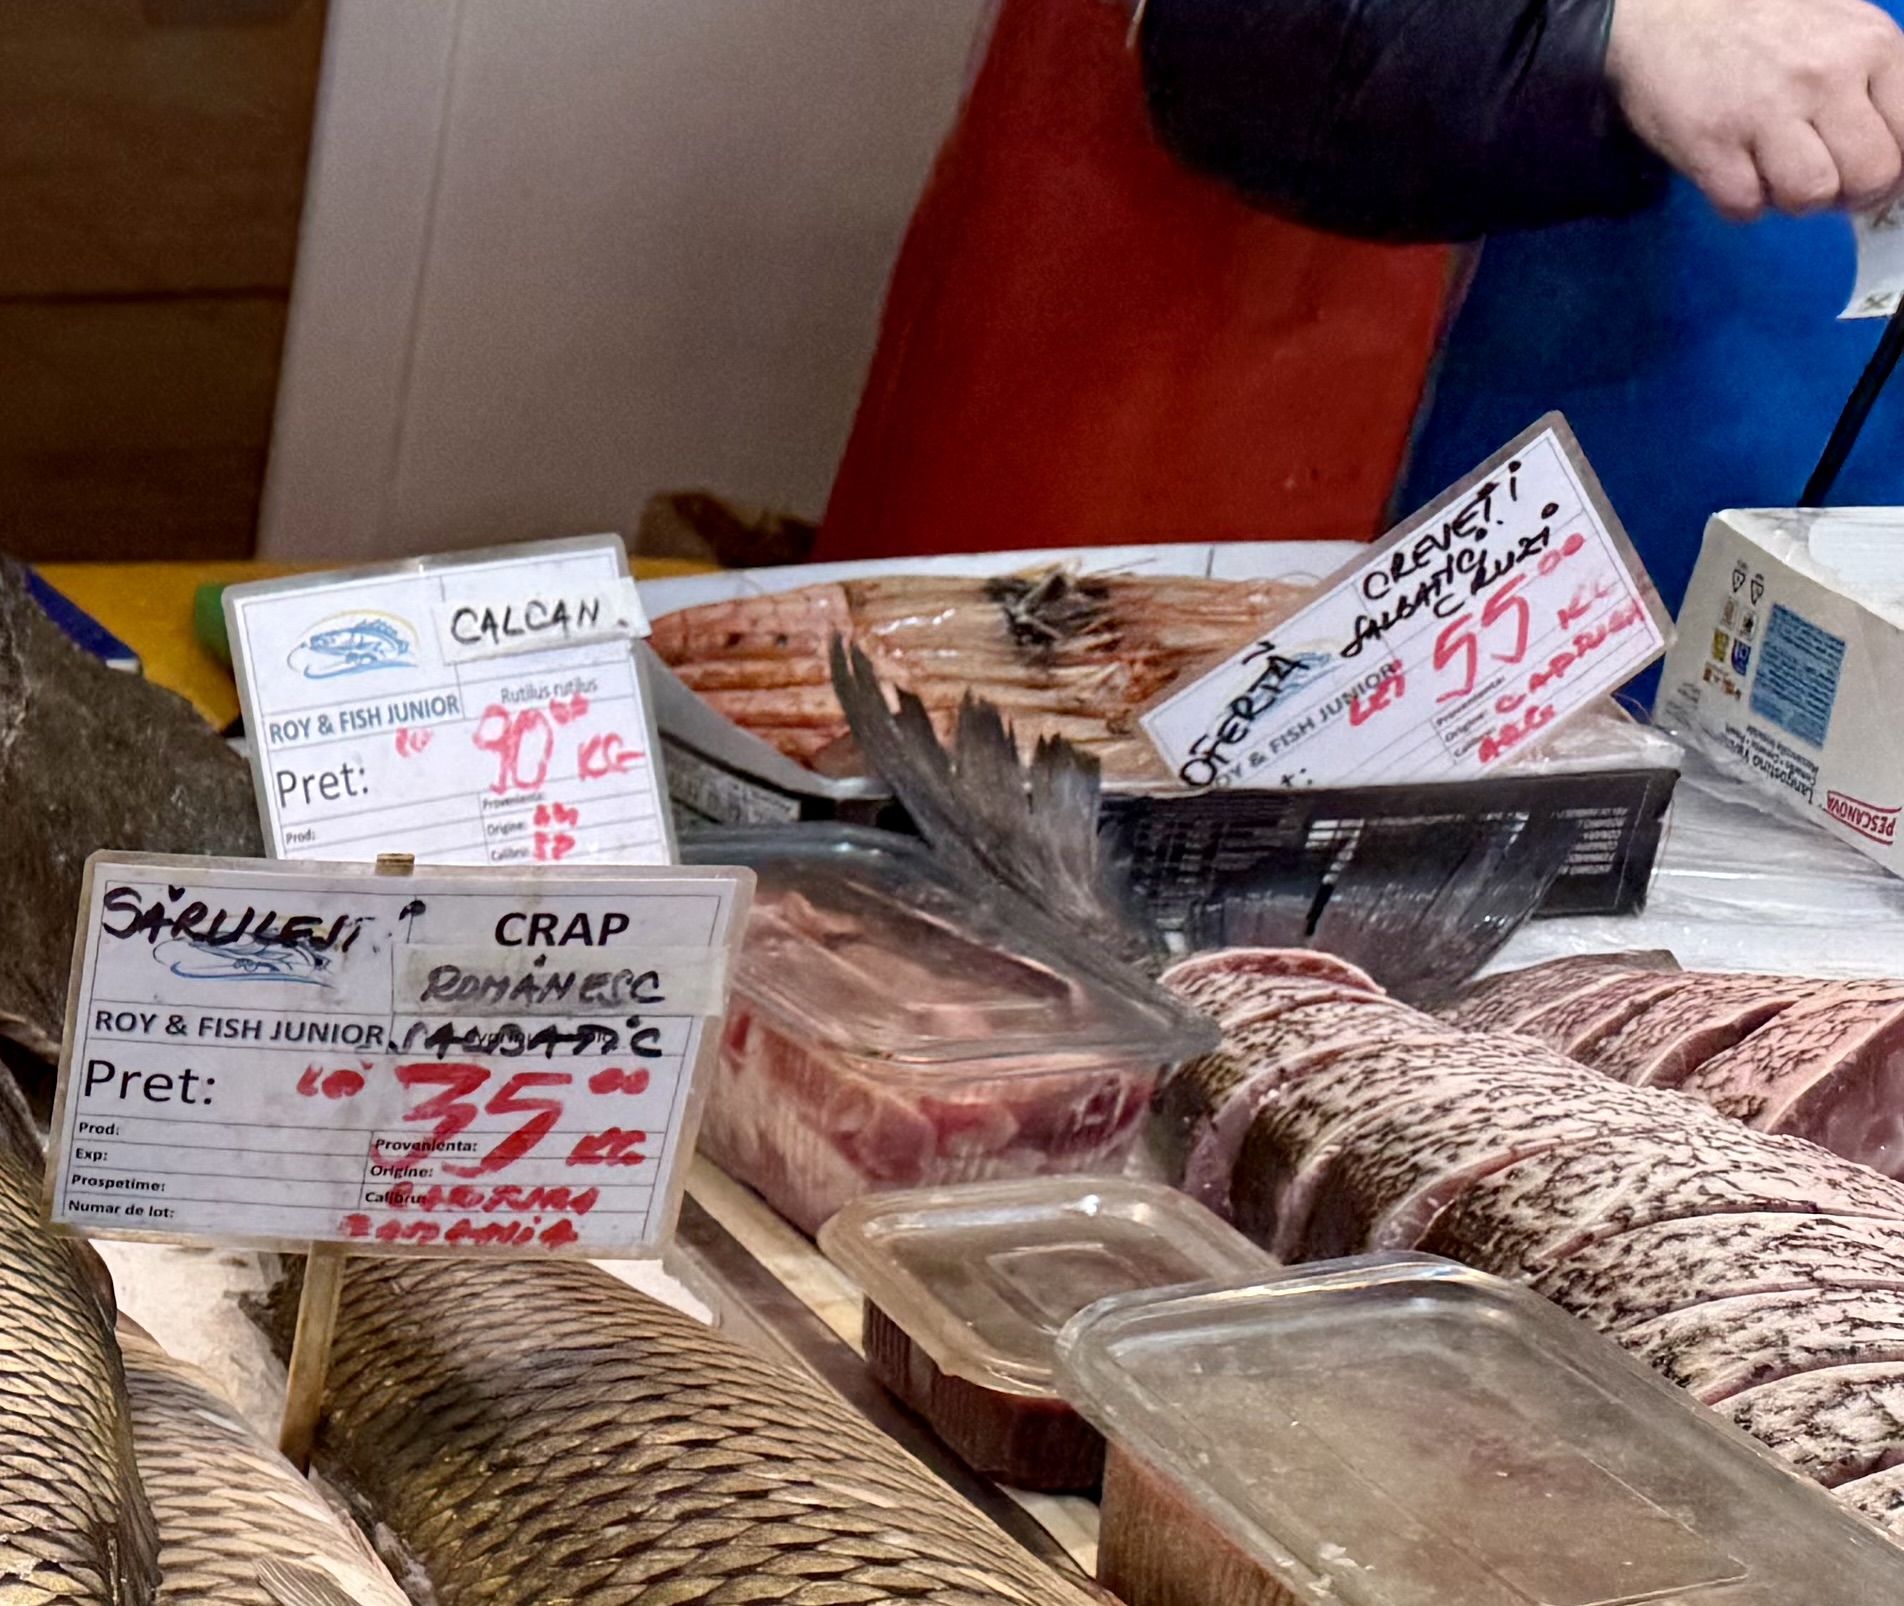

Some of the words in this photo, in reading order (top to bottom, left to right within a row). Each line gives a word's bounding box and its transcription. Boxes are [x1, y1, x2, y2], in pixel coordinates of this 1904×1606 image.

[451, 599, 599, 646] CALCAN
[1433, 573, 1529, 703] 55
[270, 720, 311, 744] ROY
[318, 714, 334, 735] &
[340, 706, 381, 733] FISH
[388, 695, 460, 725] JUNIOR
[1215, 765, 1242, 788] OY
[1249, 752, 1268, 767] &
[1269, 716, 1316, 754] FISH
[1318, 661, 1395, 722] JUNIOR
[276, 763, 369, 808] Pret:
[472, 704, 554, 795] 90
[1827, 798, 1896, 836] PESCANOVA
[495, 912, 630, 947] CRAP
[96, 1011, 158, 1035] ROY
[165, 1014, 187, 1036] &
[199, 1017, 262, 1040] FISH
[271, 1020, 384, 1045] JUNIOR
[79, 1122, 119, 1136] Prod:
[84, 1060, 215, 1105] Pret:
[369, 1063, 572, 1178] 35
[76, 1148, 108, 1161] Exp:
[375, 1138, 478, 1154] Provenienta:
[72, 1174, 165, 1191] Prospetime:
[370, 1165, 433, 1179] Origine:
[68, 1200, 119, 1215] Numar
[125, 1204, 143, 1216] de
[149, 1206, 175, 1218] lot:
